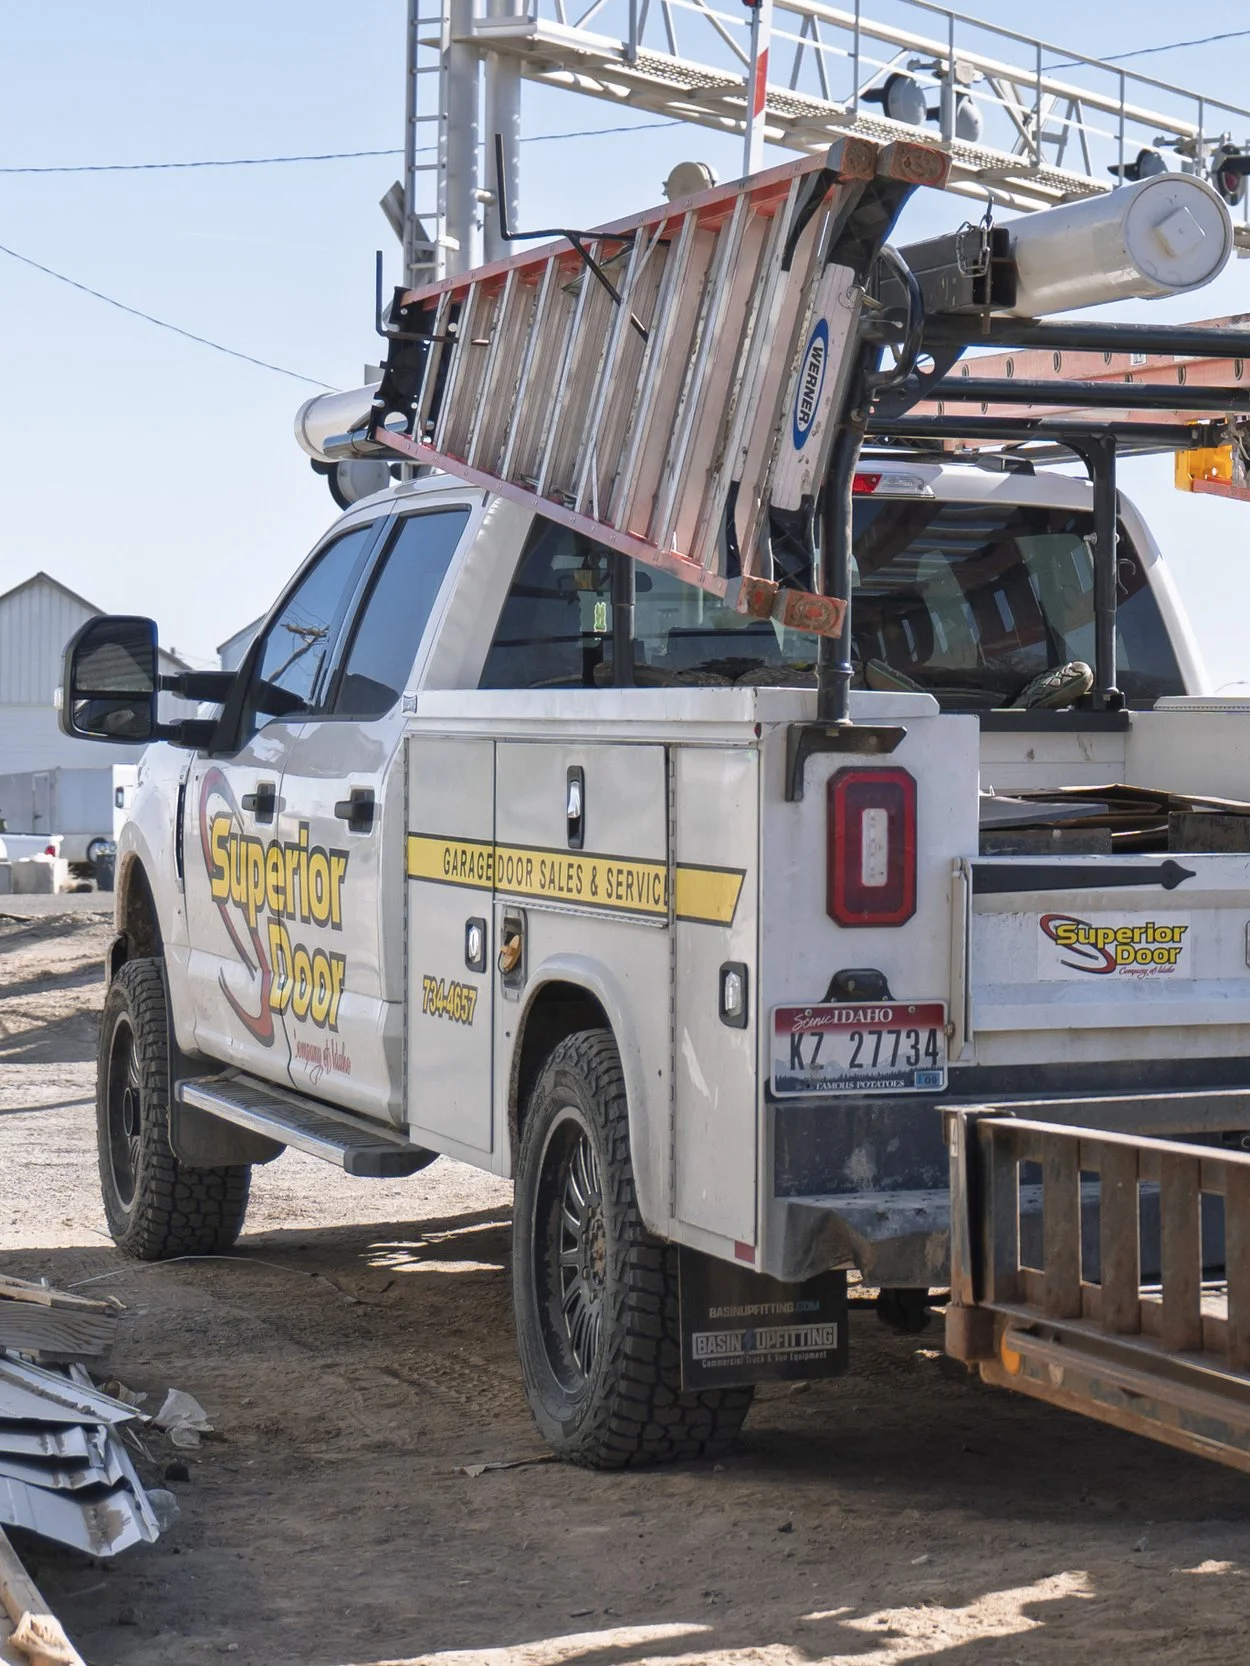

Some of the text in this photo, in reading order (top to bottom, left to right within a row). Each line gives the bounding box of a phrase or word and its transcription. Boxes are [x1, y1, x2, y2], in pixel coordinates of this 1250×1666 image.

[798, 346, 824, 426] WERNER
[209, 810, 350, 932] Superior
[443, 847, 494, 881] GARAGE
[497, 855, 533, 886] DOOR
[539, 860, 584, 895] SALES
[589, 866, 599, 897] &
[1055, 921, 1189, 950] Superior
[1115, 943, 1184, 966] Door
[267, 915, 347, 1033] Door
[421, 974, 479, 1027] 734-4657
[792, 1007, 893, 1031] Scenic IDAHO
[789, 1028, 939, 1071] KZ 27734
[816, 1079, 905, 1090] FAMOUS POTATOES
[697, 1327, 833, 1354] BASIN UPFITTING
